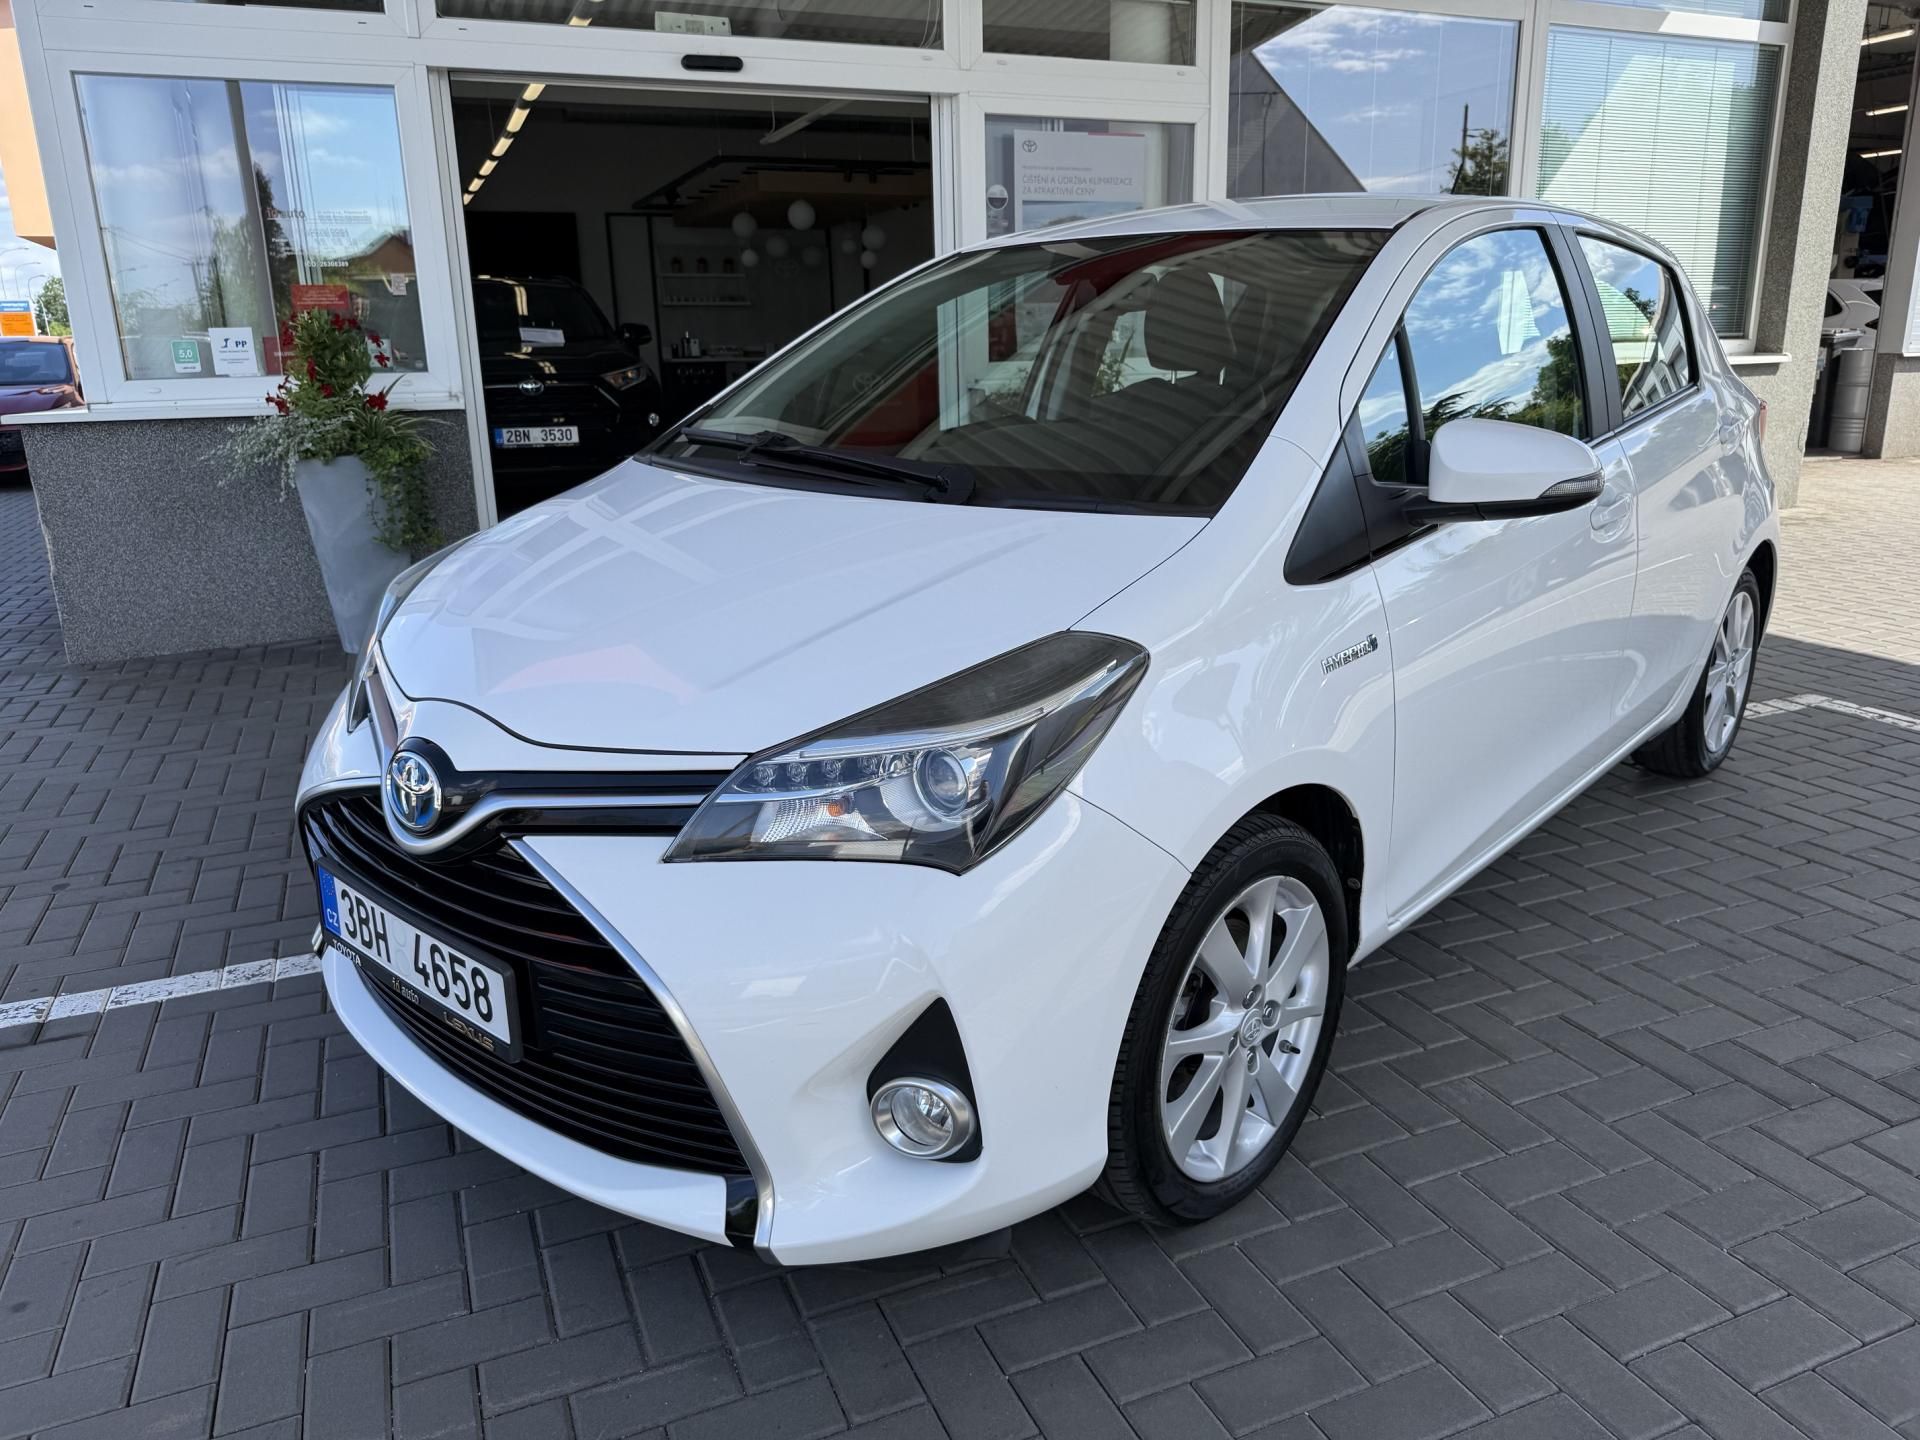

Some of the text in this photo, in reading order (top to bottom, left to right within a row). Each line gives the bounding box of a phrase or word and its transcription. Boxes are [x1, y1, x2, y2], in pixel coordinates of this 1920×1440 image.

[1022, 186, 1031, 195] ZA
[1075, 186, 1096, 196] CENY
[1088, 177, 1133, 187] KLIMATIZACE
[506, 429, 531, 443] 2BN
[541, 428, 573, 442] 3530
[1321, 640, 1372, 675] HYBRID
[326, 889, 493, 1023] CZ 3BH 4658
[332, 939, 362, 967] TOYOTA
[443, 1011, 494, 1050] LEXUS
